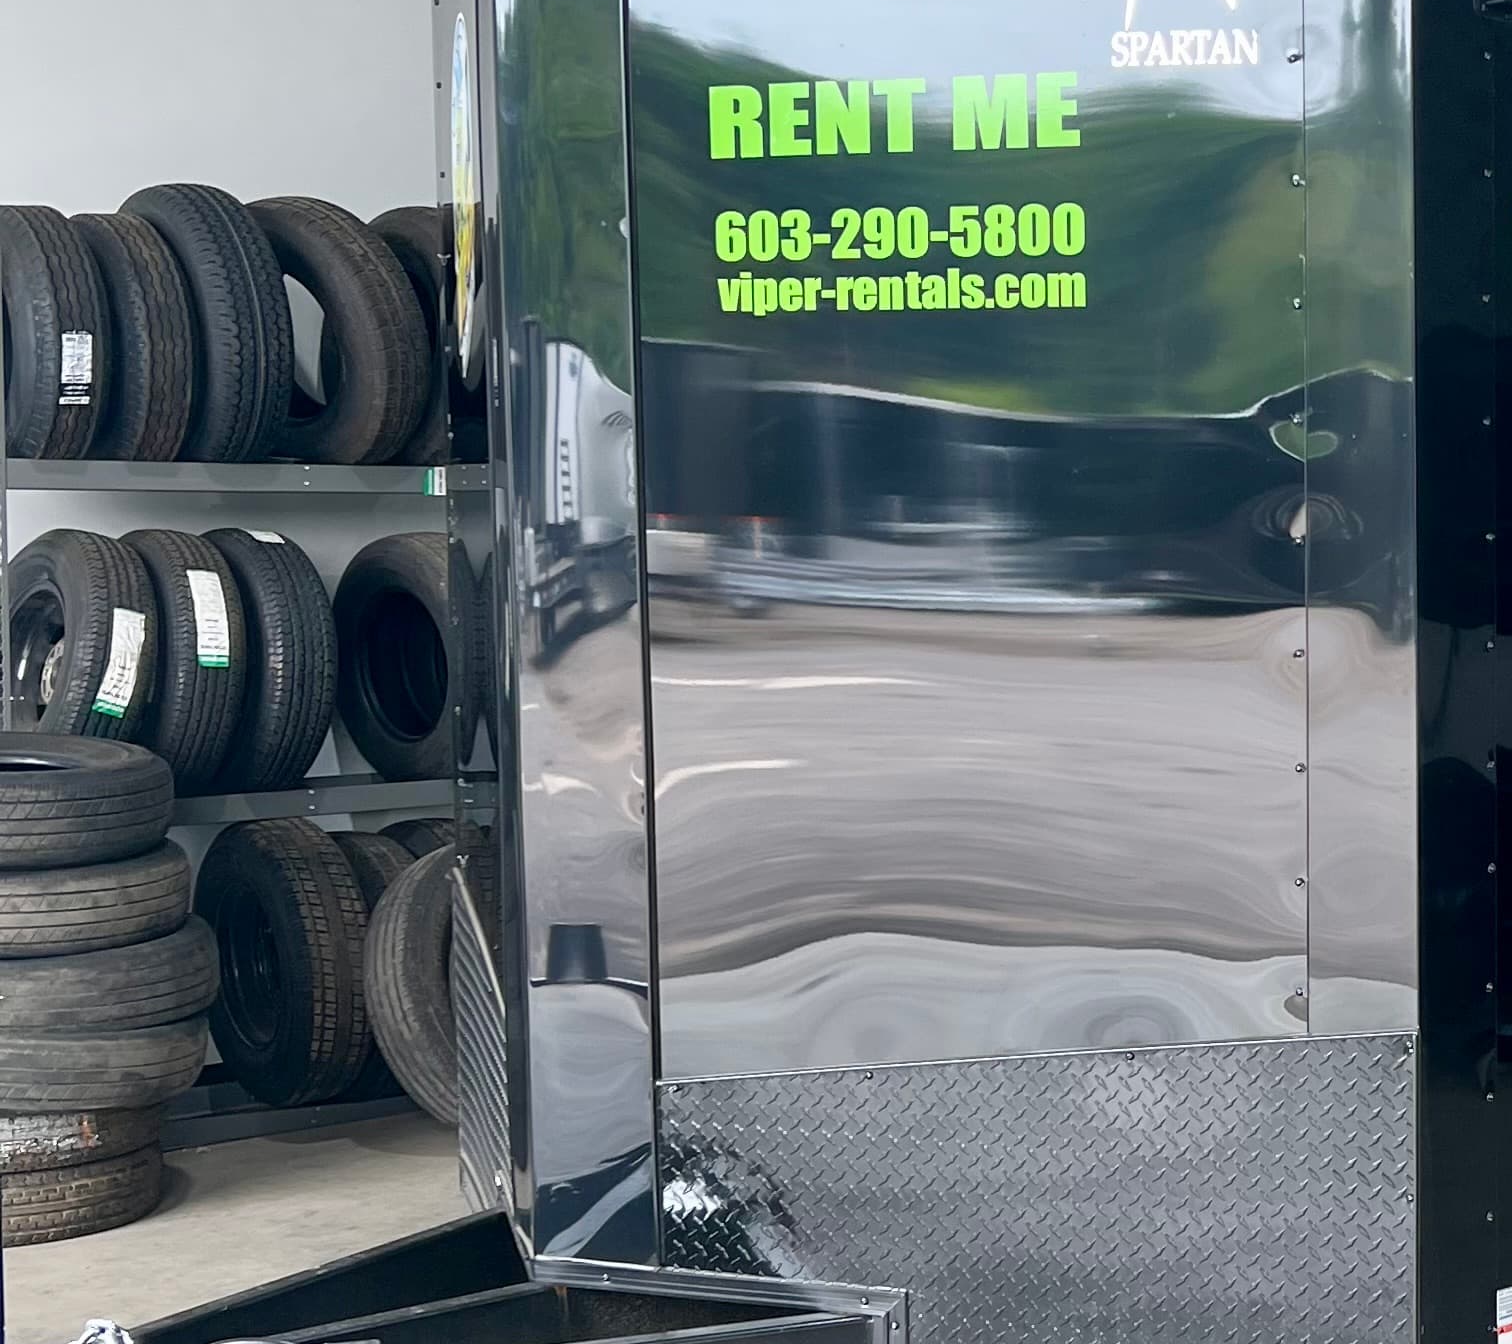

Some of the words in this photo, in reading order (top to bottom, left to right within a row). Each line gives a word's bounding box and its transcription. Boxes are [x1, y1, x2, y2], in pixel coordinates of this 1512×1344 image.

[1110, 28, 1259, 68] SPARTAN
[708, 77, 925, 160] RENT
[952, 71, 1082, 152] ME
[715, 202, 1086, 263] 603-290-5800
[717, 267, 1087, 318] viper-rentals.com
